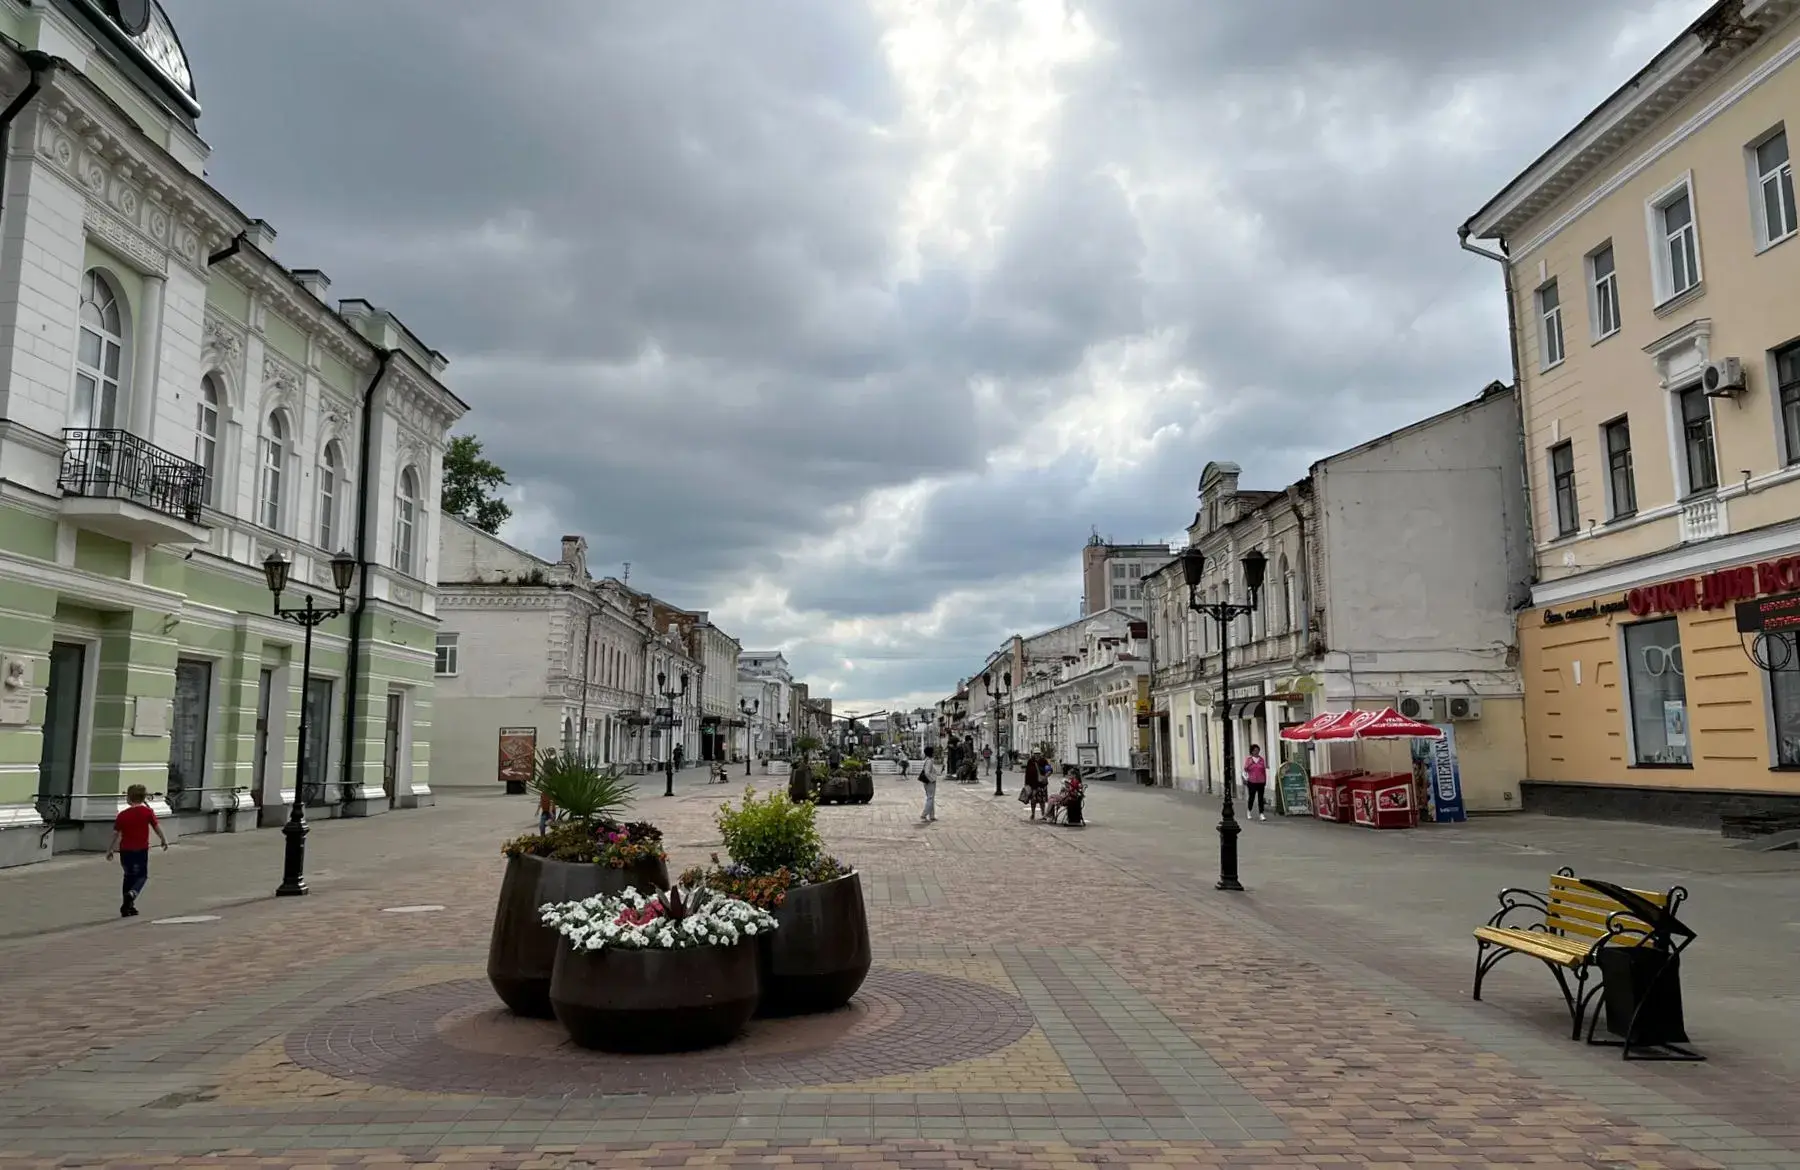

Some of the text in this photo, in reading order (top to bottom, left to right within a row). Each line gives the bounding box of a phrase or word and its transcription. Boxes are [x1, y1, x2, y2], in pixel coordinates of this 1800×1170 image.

[1628, 579, 1698, 616] ОЧКИ
[1701, 566, 1756, 611] ДЛЯ
[1436, 732, 1454, 798] СЕНЕЖСКА
